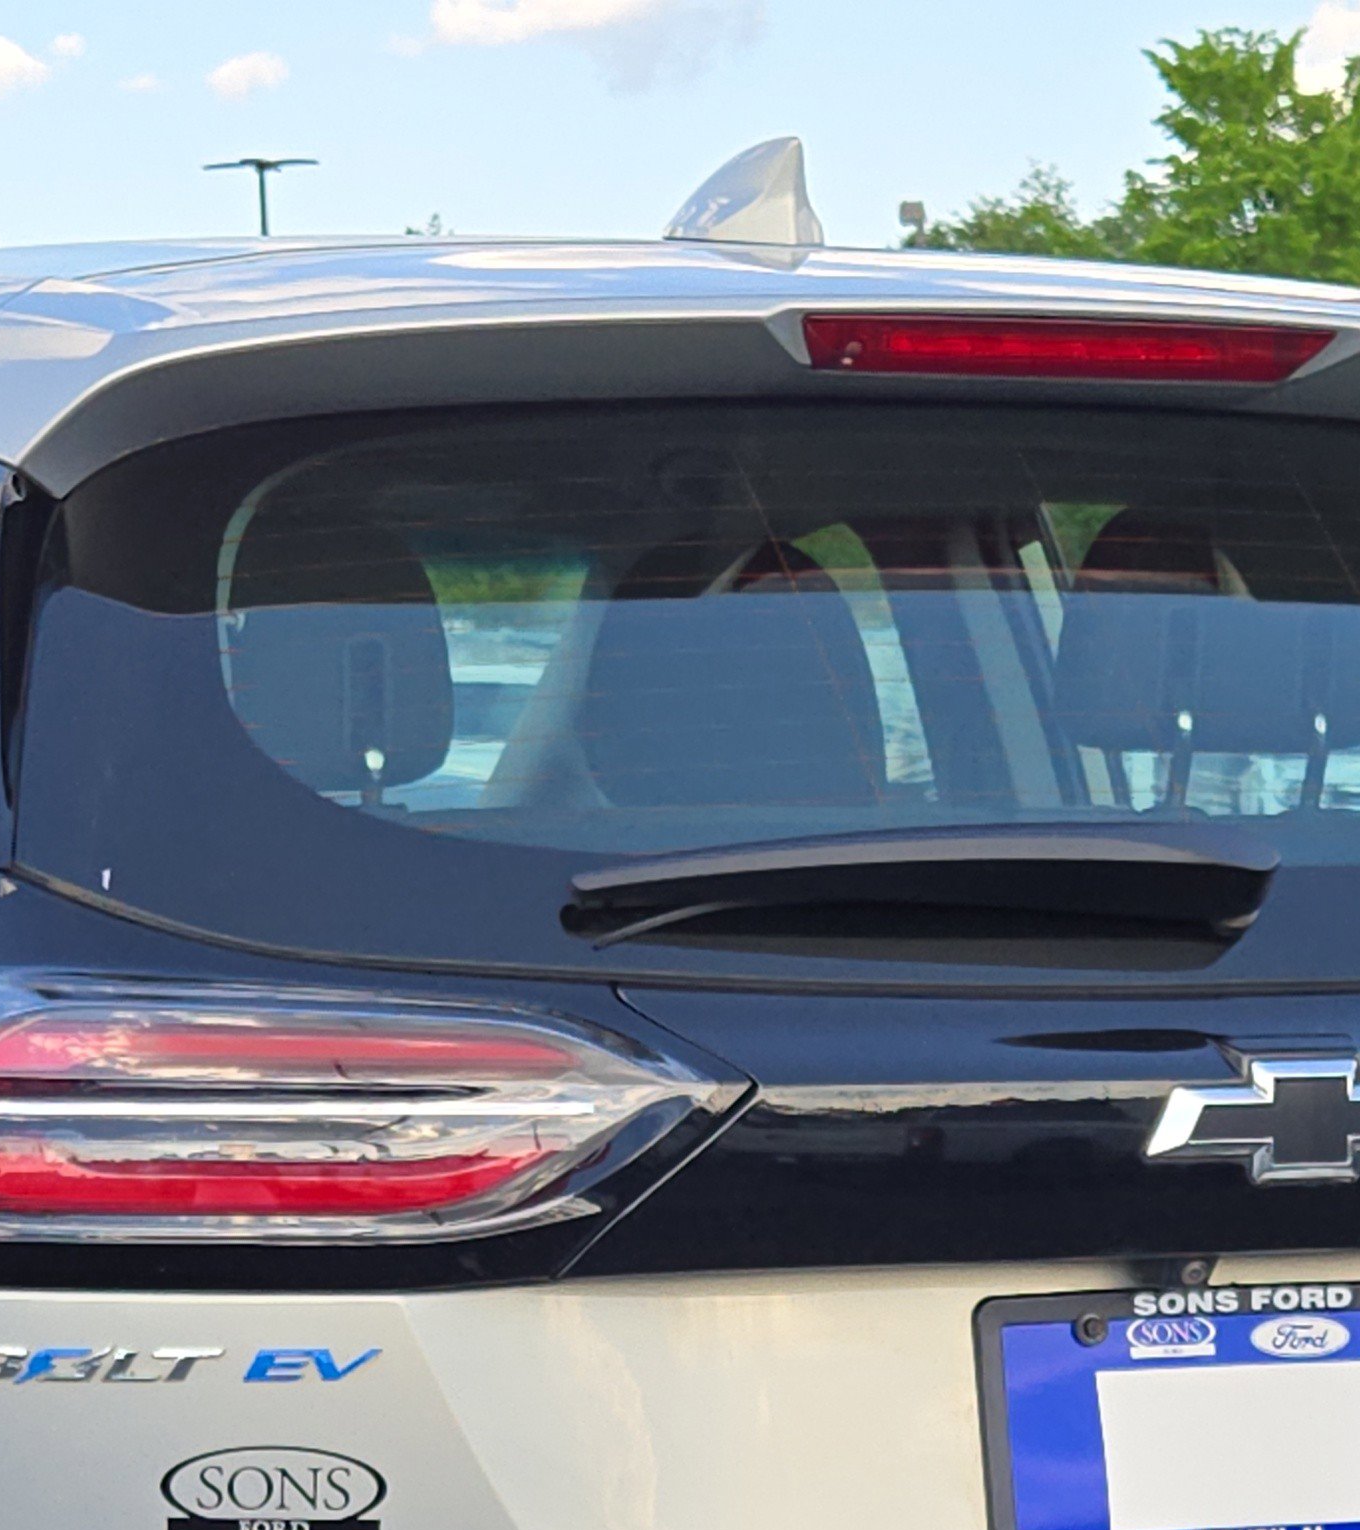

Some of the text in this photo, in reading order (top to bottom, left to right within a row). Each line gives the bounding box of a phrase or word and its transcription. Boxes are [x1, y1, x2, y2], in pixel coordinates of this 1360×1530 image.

[1134, 1285, 1353, 1316] SONS FORD
[1140, 1319, 1203, 1345] SONS
[1272, 1324, 1328, 1350] Ford
[243, 1348, 383, 1383] EV
[196, 1466, 351, 1511] SONS
